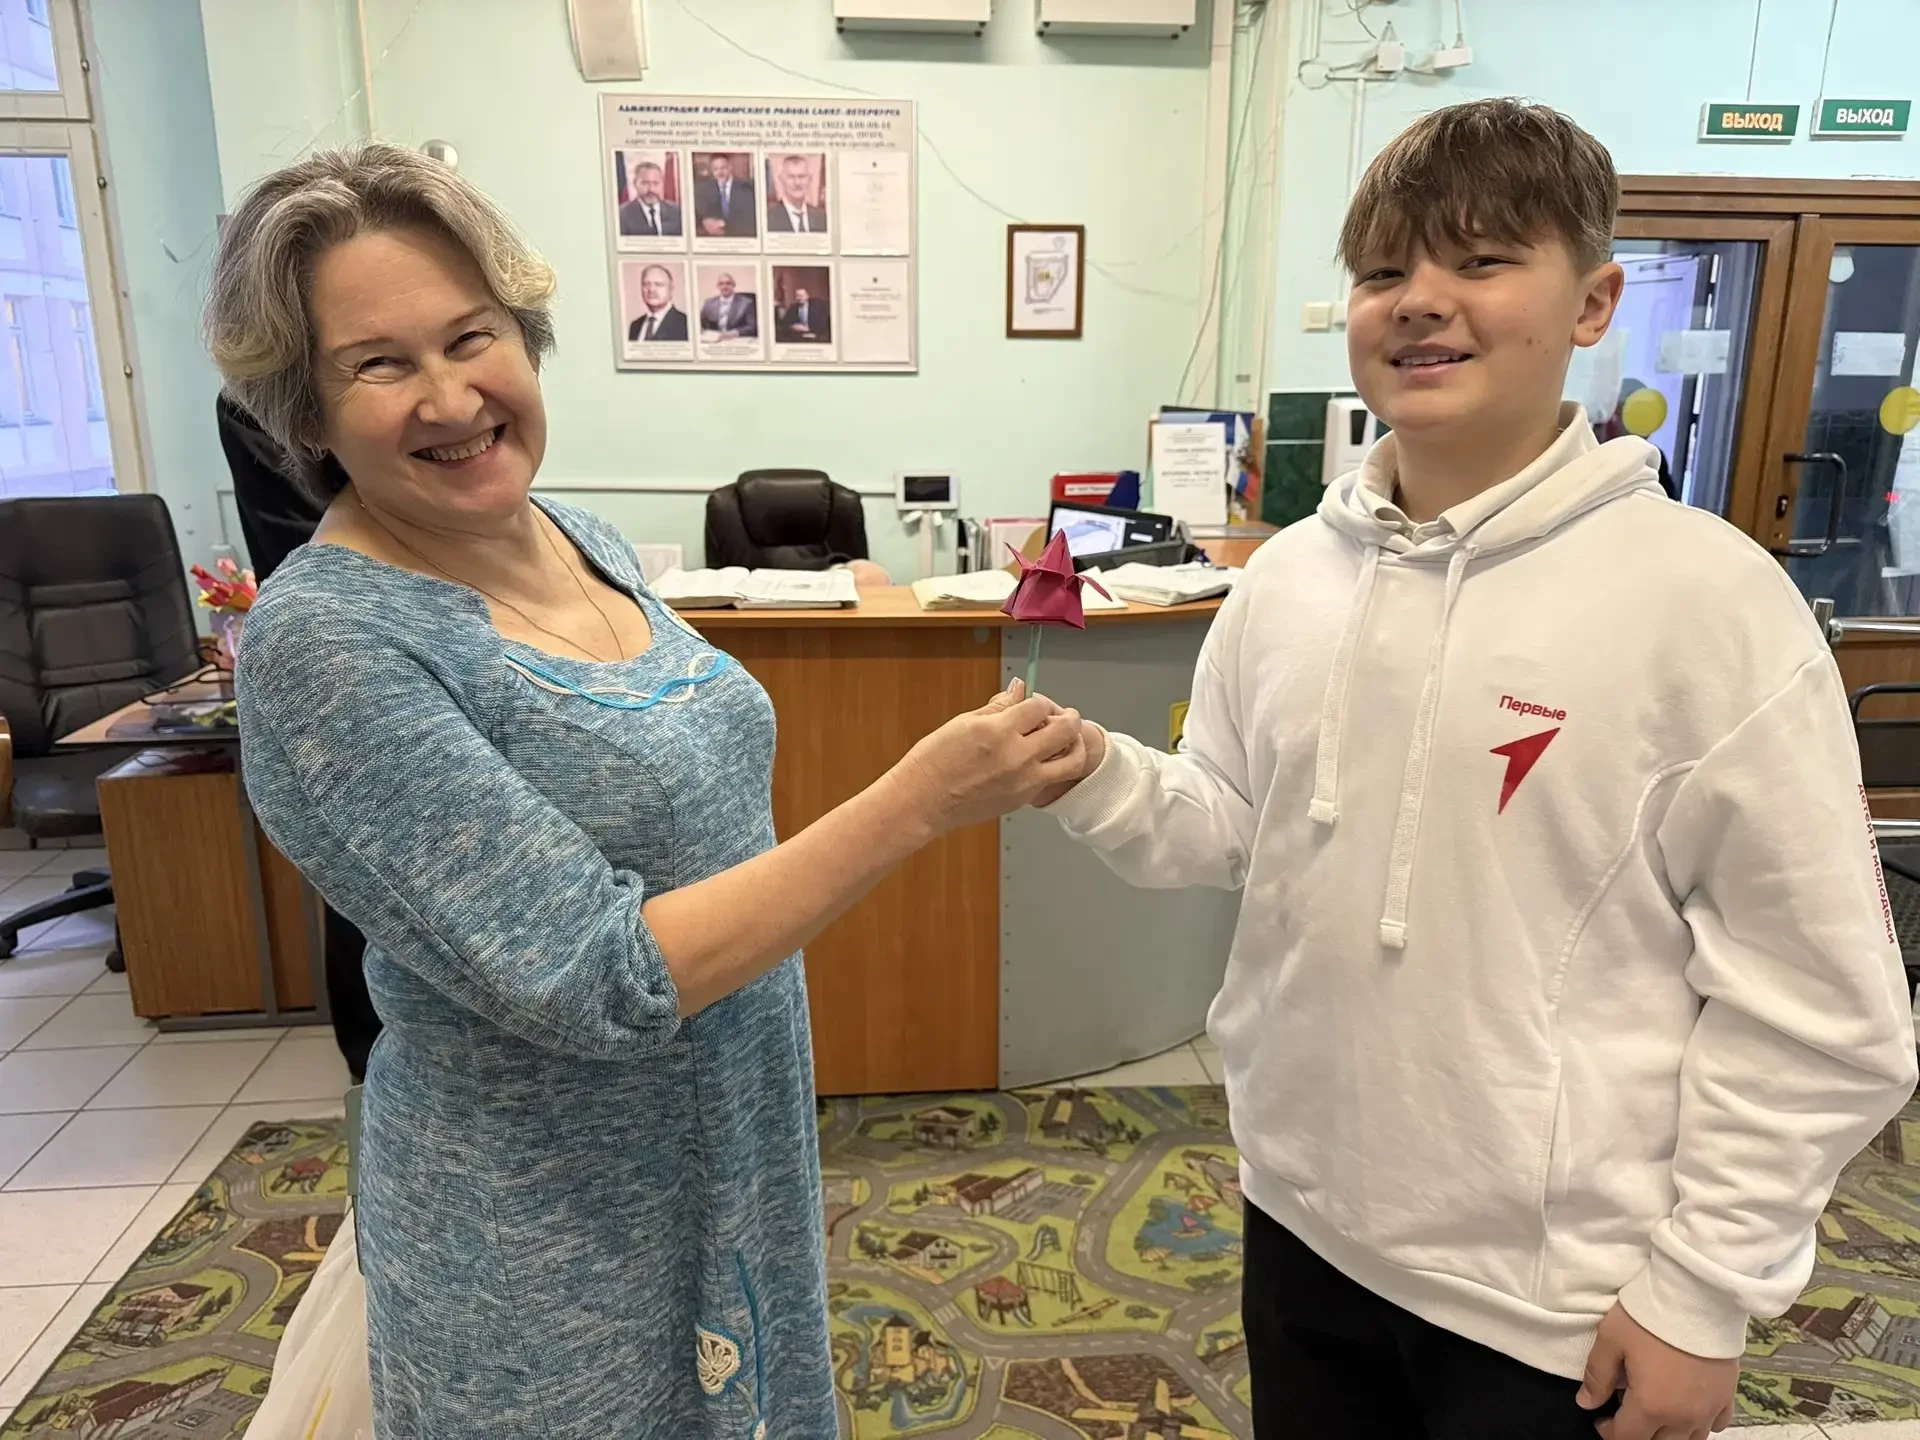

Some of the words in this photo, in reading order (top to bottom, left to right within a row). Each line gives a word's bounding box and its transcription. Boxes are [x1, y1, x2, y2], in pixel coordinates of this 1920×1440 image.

[1722, 112, 1783, 131] ВЫХОД
[1836, 108, 1893, 126] ВЫХОД
[1499, 695, 1567, 721] Первые
[1869, 838, 1877, 850] и
[1872, 854, 1895, 944] молодежи
